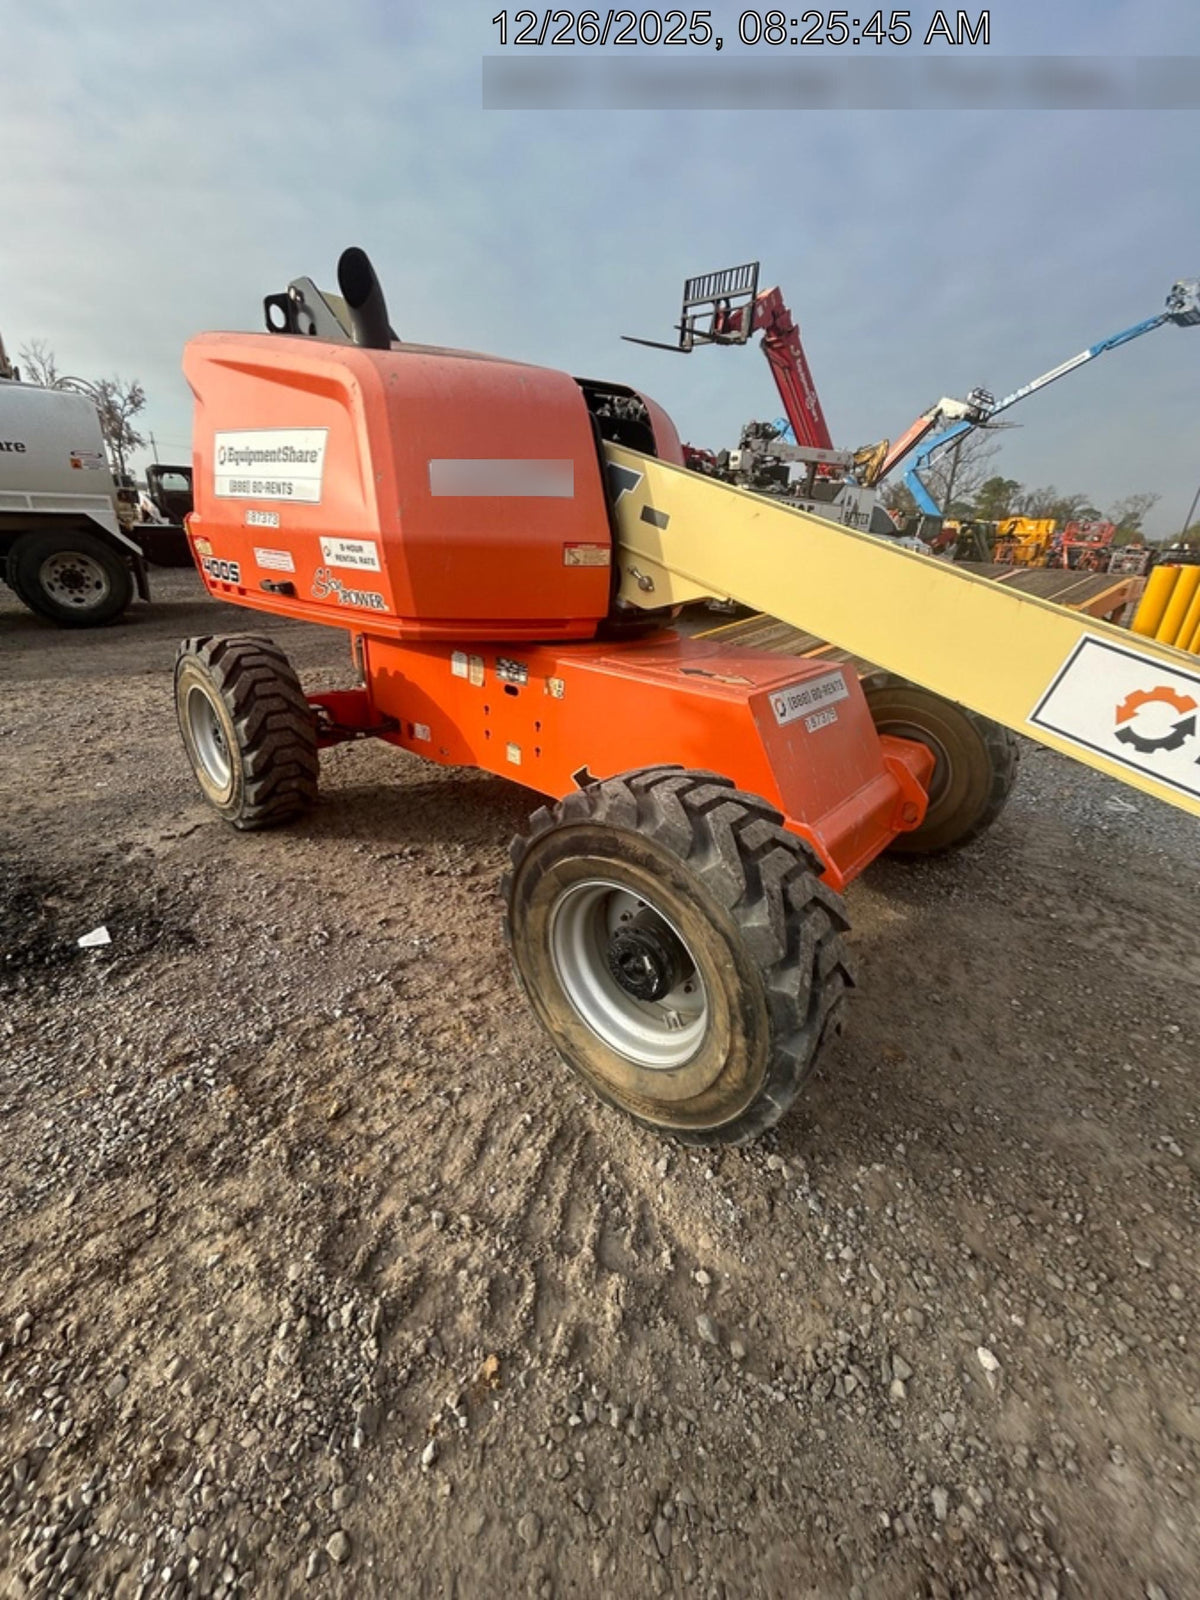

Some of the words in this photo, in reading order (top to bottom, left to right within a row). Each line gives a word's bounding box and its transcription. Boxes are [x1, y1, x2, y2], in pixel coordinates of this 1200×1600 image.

[228, 446, 319, 466] EquipmentShare
[202, 559, 240, 583] 400S
[339, 589, 385, 609] POWER
